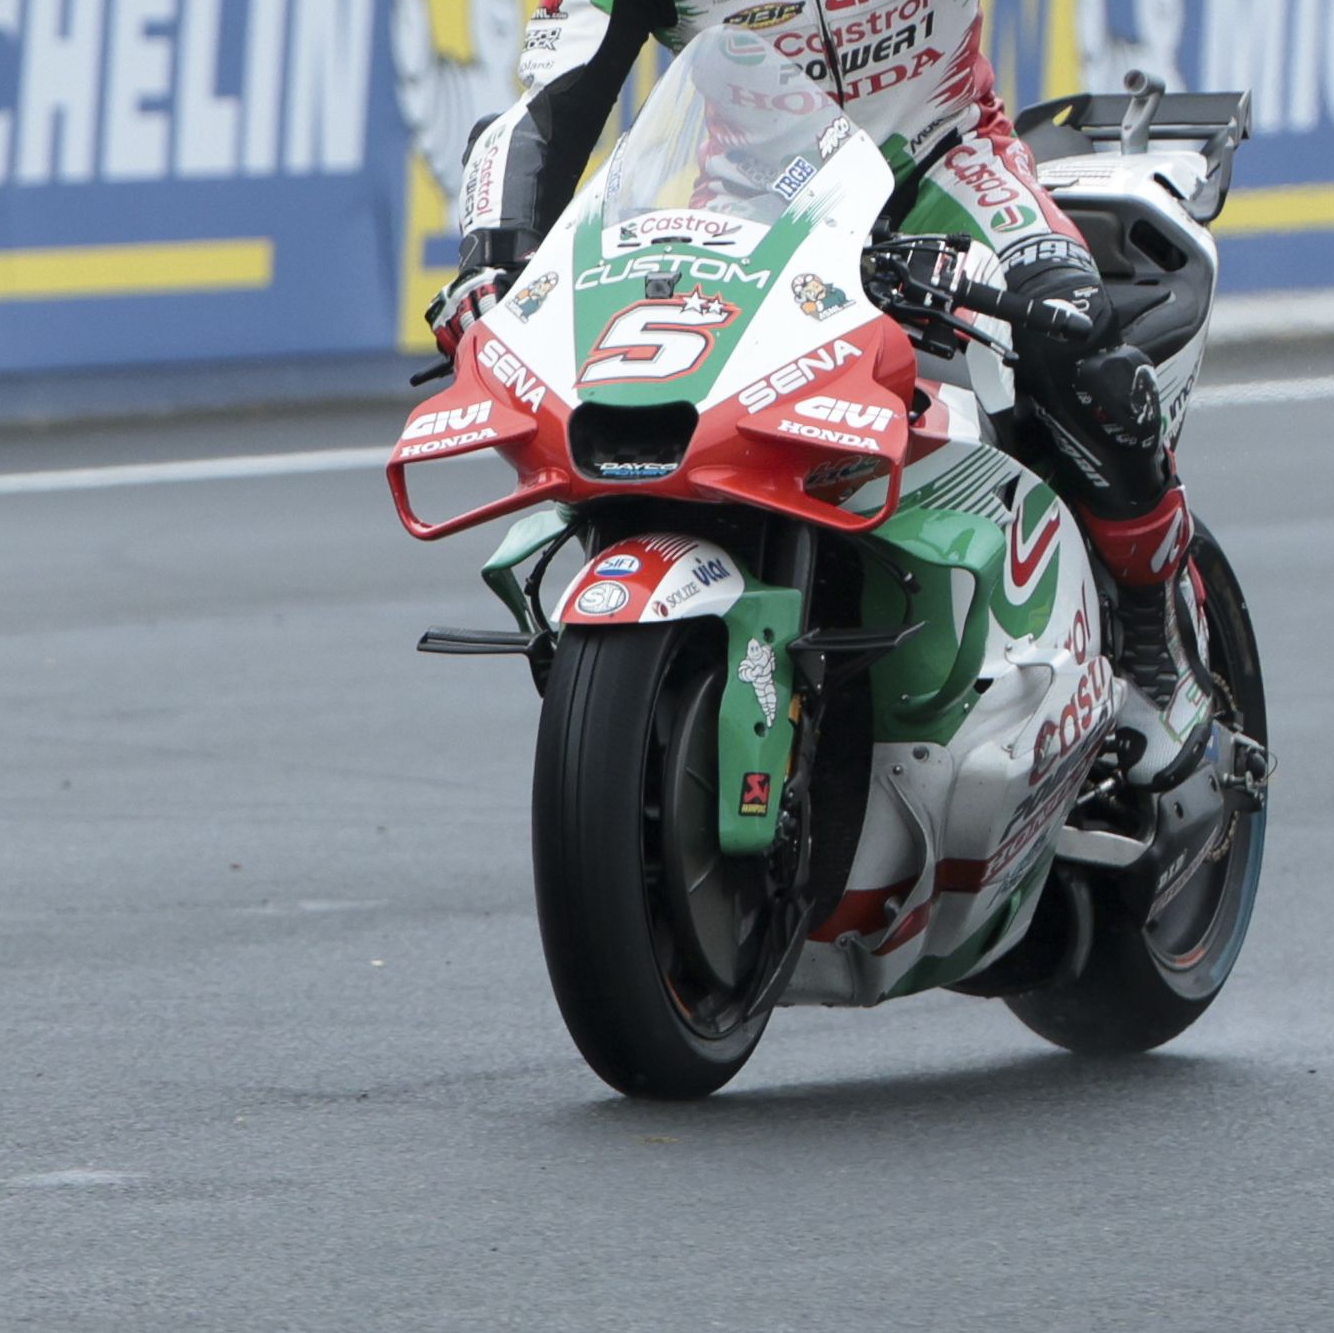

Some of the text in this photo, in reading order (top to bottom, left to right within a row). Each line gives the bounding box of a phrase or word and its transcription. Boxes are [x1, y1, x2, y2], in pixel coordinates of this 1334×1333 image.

[727, 46, 946, 115] HONDA
[476, 146, 499, 216] Castrol
[774, 156, 816, 200] IRGE
[640, 215, 731, 237] Castrol
[575, 254, 771, 290] CUSTOM
[573, 298, 742, 389] 5
[478, 339, 548, 414] SENA
[738, 339, 863, 414] SENA
[402, 400, 492, 439] GIVI
[794, 396, 894, 431] GIVI
[400, 428, 496, 458] HONDA
[777, 420, 880, 451] HONDA
[597, 462, 678, 470] DAYCO
[666, 582, 702, 609] SOLIZE
